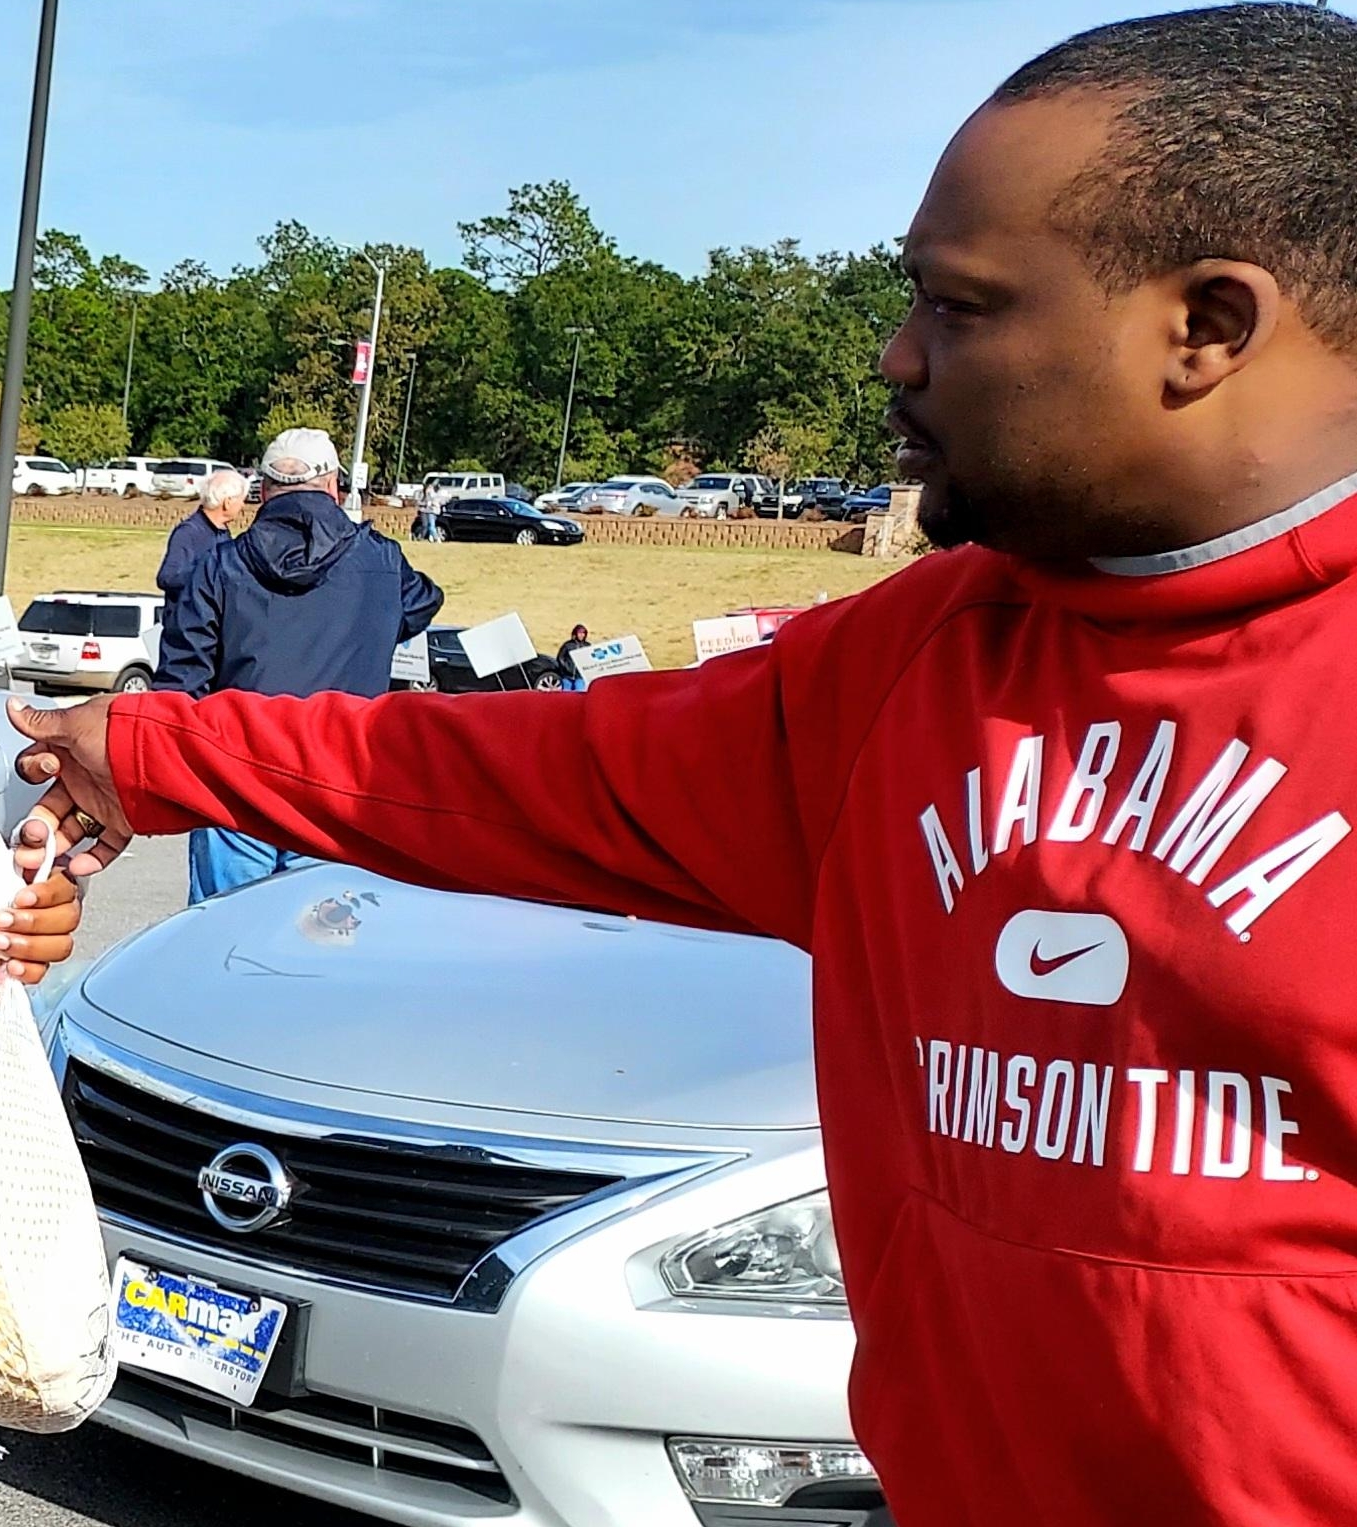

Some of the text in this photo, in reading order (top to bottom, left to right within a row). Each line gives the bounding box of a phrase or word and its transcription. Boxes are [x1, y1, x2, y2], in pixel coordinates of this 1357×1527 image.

[919, 719, 1353, 937] ALABAMA
[915, 1035, 1115, 1167] RIMSON
[203, 1172, 277, 1206] NISSAN
[116, 1329, 140, 1344] HE
[146, 1338, 183, 1357] AUTO
